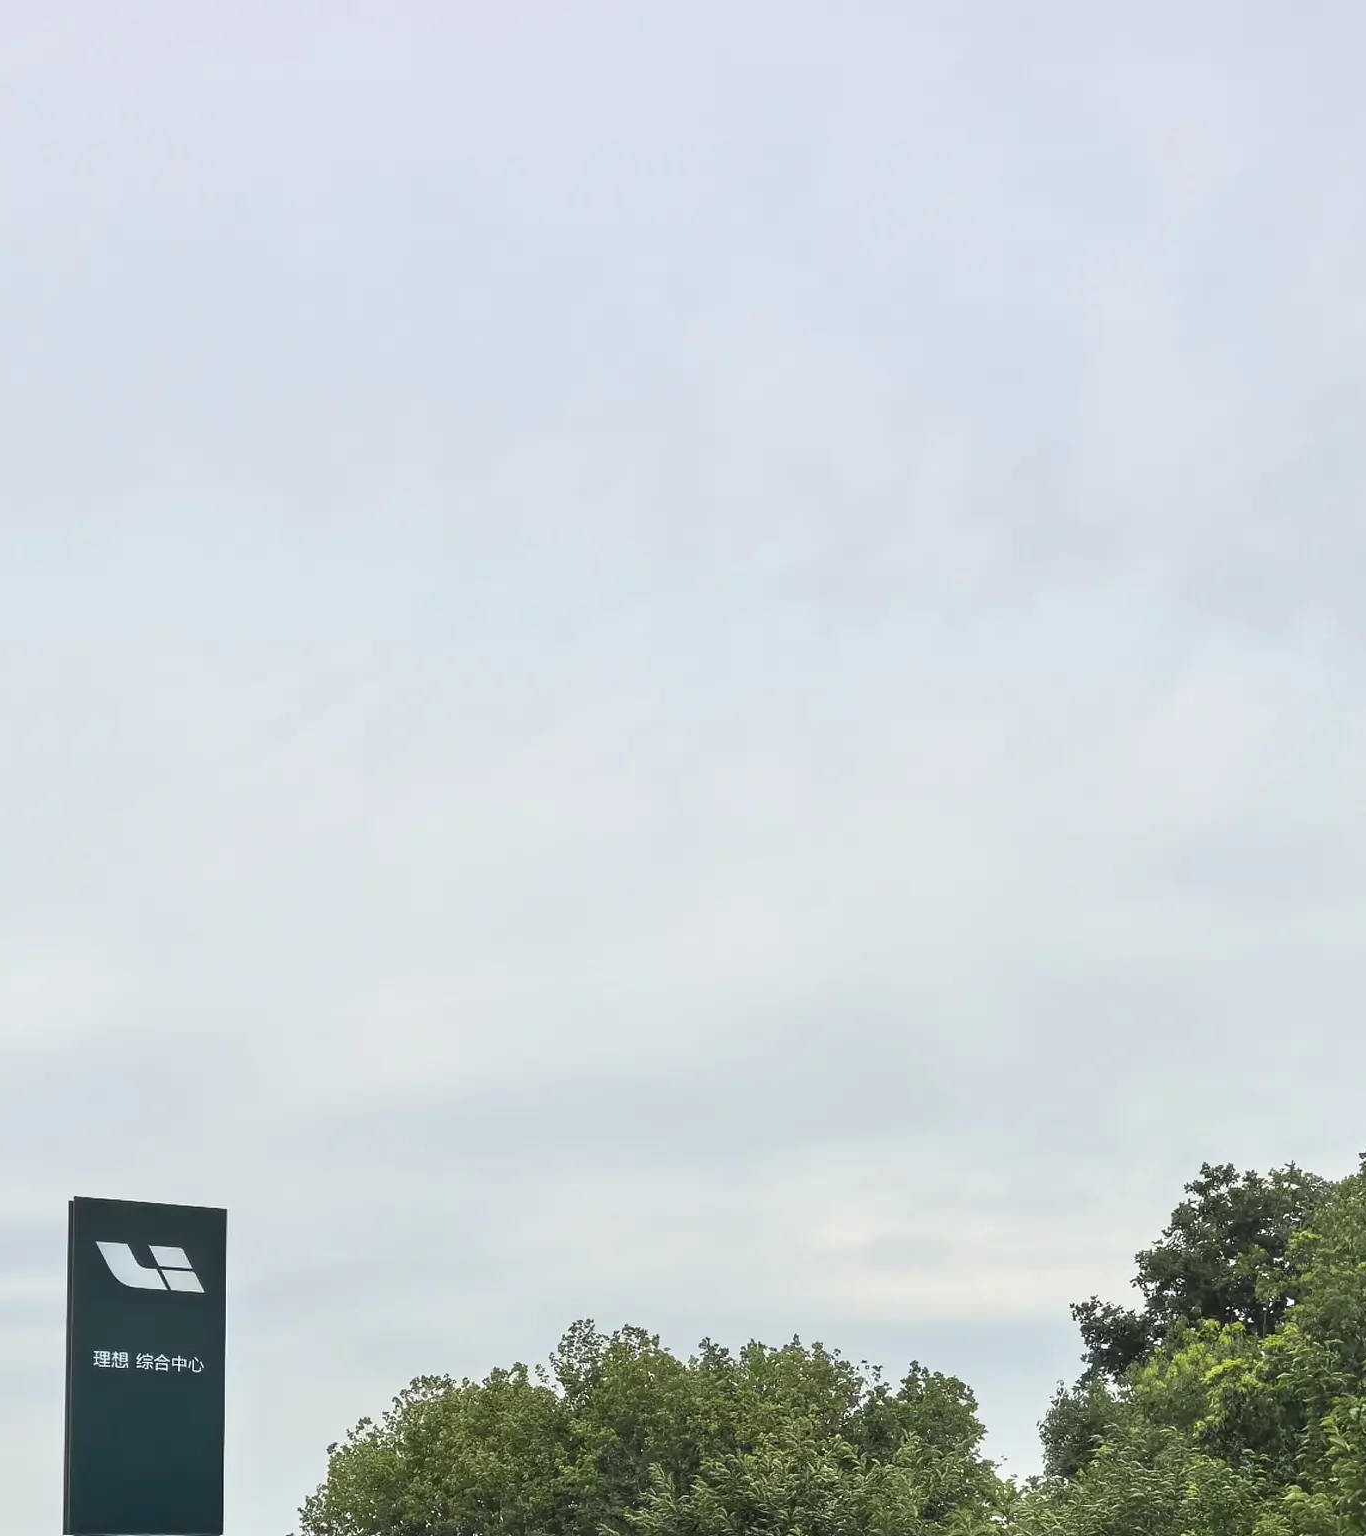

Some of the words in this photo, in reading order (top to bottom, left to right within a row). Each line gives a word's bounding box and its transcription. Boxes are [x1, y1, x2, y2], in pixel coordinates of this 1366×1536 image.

[93, 1350, 129, 1369] 理想
[136, 1353, 205, 1373] 综合中心
